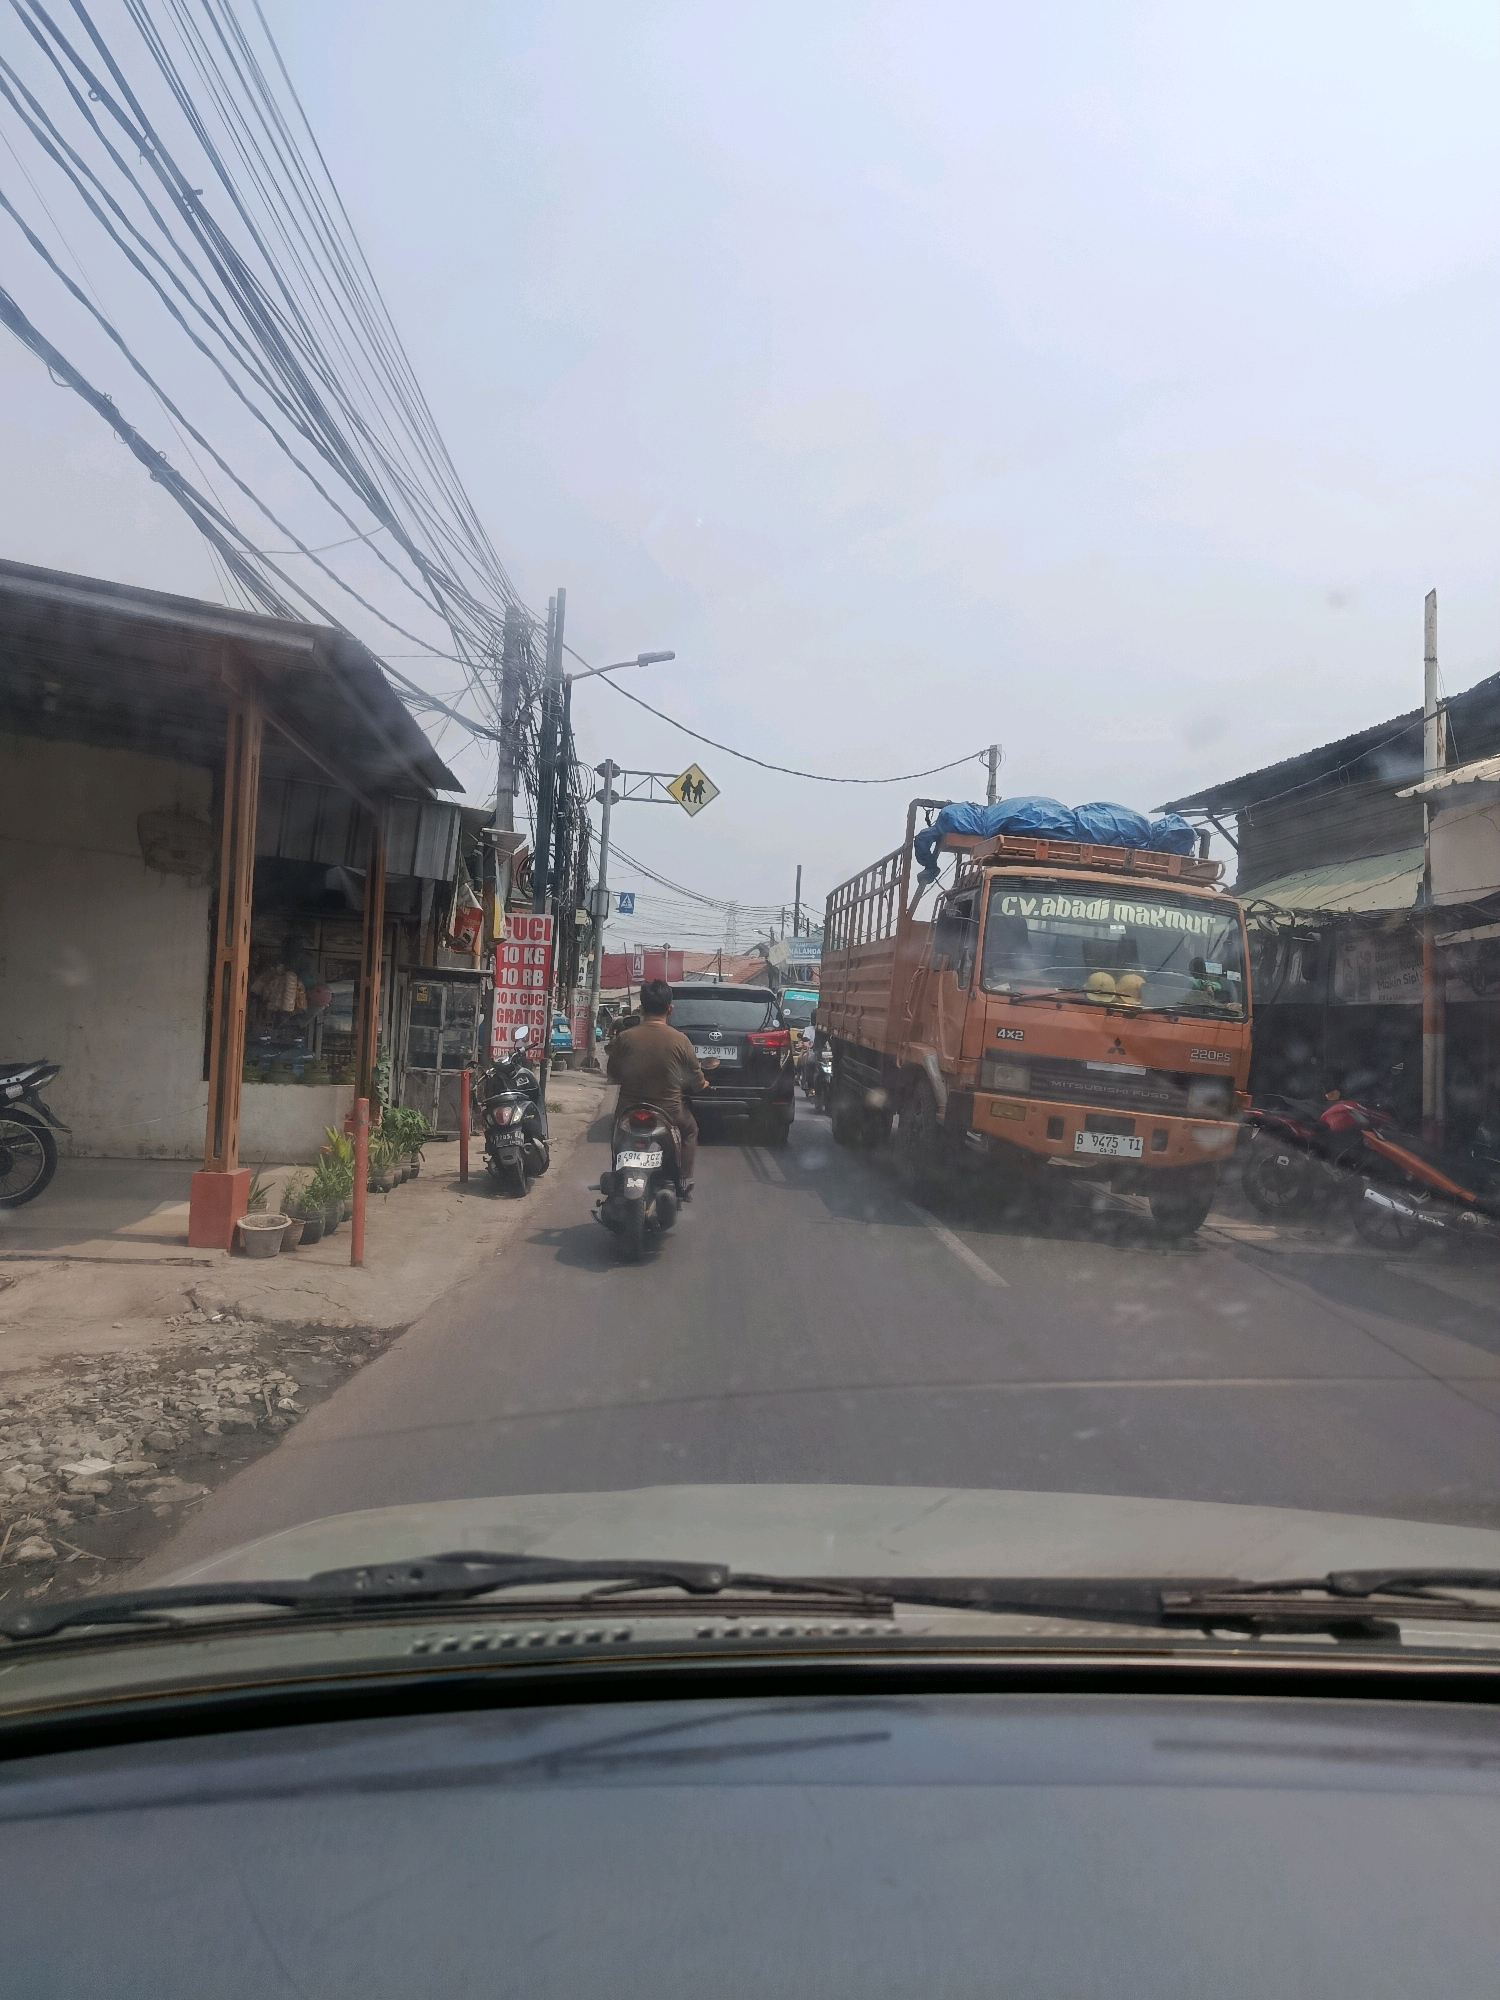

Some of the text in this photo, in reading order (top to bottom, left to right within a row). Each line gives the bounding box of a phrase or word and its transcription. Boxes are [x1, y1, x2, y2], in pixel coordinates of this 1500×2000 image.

[505, 917, 551, 941] CUCI
[502, 945, 545, 965] 10 KG
[500, 967, 543, 987] 10 RB
[497, 992, 507, 1004] 10
[519, 993, 545, 1006] CUCI
[496, 1008, 545, 1026] GRATIS
[724, 1047, 735, 1055] TYP
[1051, 1080, 1169, 1100] MITSUBISHI FUSO
[1077, 1133, 1140, 1150] B 9475 TI
